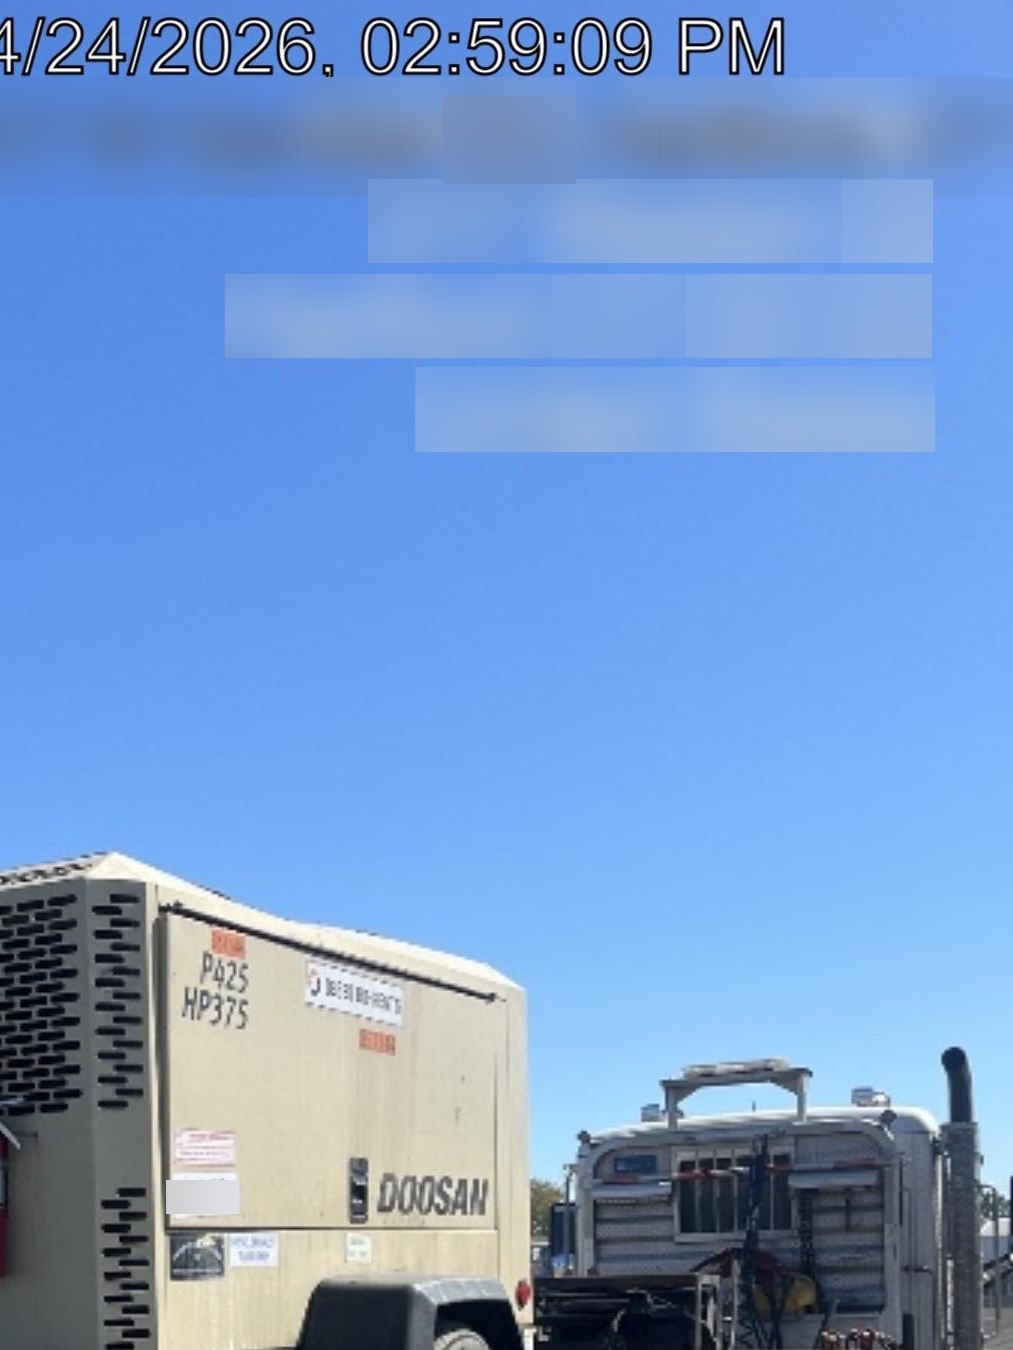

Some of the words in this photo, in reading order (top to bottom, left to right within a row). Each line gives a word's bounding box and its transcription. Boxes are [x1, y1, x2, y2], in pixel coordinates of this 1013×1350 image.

[199, 950, 249, 993] P425
[181, 986, 249, 1030] HP375
[376, 1172, 489, 1216] DOOSAN
